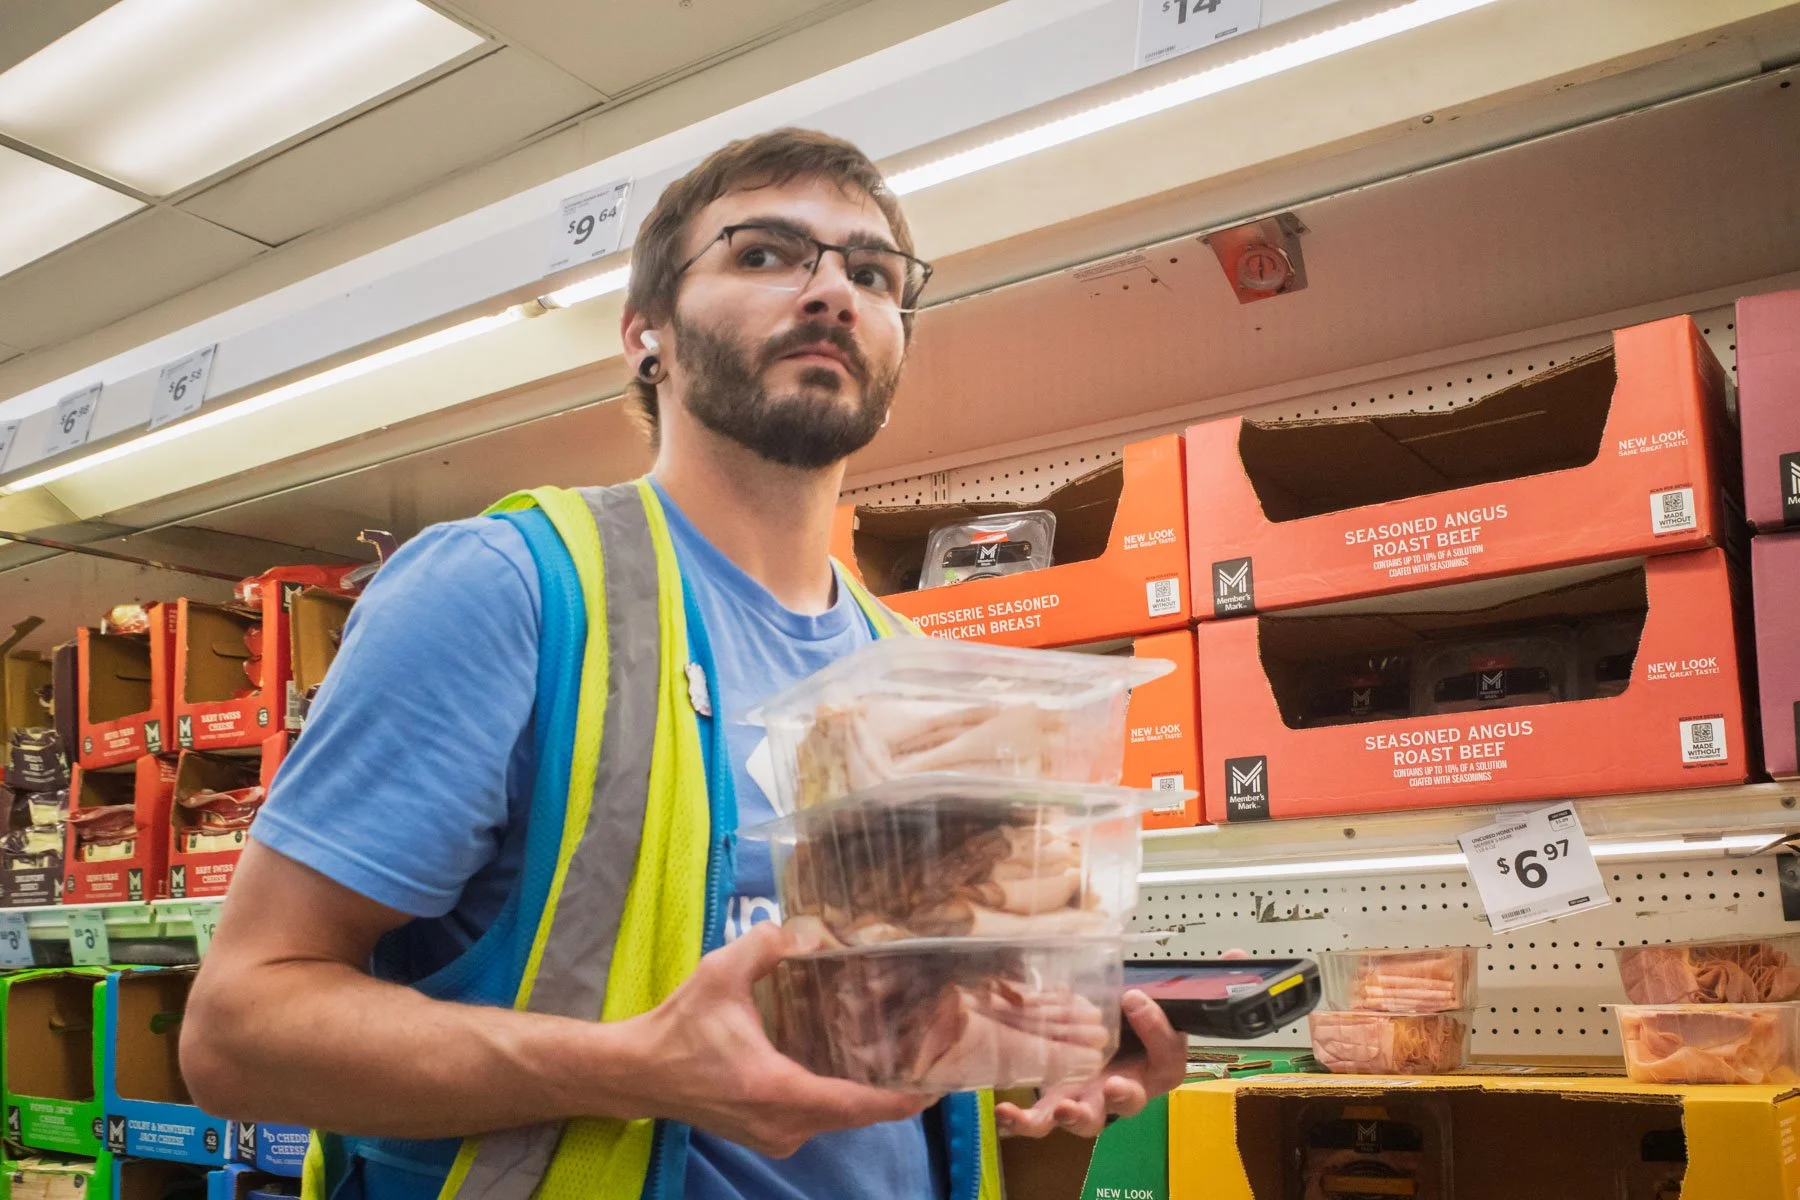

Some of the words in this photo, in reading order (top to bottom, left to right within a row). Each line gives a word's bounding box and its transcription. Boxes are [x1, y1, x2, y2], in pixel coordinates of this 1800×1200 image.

[1618, 437, 1647, 450] NEW
[1652, 429, 1686, 445] LOOK
[1659, 516, 1691, 526] WITHOUT
[1664, 511, 1684, 519] MADE
[1344, 517, 1438, 545] SEASONED
[1444, 504, 1508, 529] ANGUS
[1123, 533, 1146, 545] NEW
[1149, 528, 1175, 541] LOOK
[1373, 535, 1431, 558] ROAST
[1437, 526, 1482, 547] BEEF
[1403, 556, 1412, 565] UP
[1413, 555, 1421, 564] TO
[1438, 550, 1447, 560] OF
[1453, 544, 1483, 557] SOLUTION
[1389, 566, 1412, 578] COATED
[1413, 563, 1430, 574] WITH
[1430, 558, 1469, 573] SEASONINGS
[1216, 593, 1251, 606] Member's
[1224, 602, 1244, 612] Mark
[912, 606, 984, 628] ROTISSERIE
[988, 594, 1060, 617] SEASONED
[931, 623, 986, 641] CHICKEN
[990, 614, 1041, 634] BREAST
[1647, 661, 1677, 674] NEW
[1681, 657, 1718, 670] LOOK
[1647, 673, 1667, 681] SAME
[1669, 670, 1693, 679] GREAT
[1695, 667, 1720, 676] TASTE!
[1130, 727, 1153, 738] NEW
[1155, 724, 1180, 735] LOOK
[1365, 728, 1461, 751] SEASONED
[1467, 721, 1534, 741] ANGUS
[1393, 746, 1454, 766] ROAST
[1460, 741, 1506, 760] BEEF
[1688, 748, 1721, 757] WITHOUT
[1393, 767, 1423, 778] CONTAINS
[1424, 766, 1433, 776] UP
[1434, 765, 1443, 775] TO
[1444, 764, 1459, 774] 10%
[1460, 763, 1469, 773] OF
[1469, 763, 1475, 771] A
[1476, 760, 1508, 771] SOLUTION
[1409, 776, 1433, 787] COATED
[1433, 774, 1450, 785] WITH
[1452, 771, 1492, 784] SEASONINGS
[1229, 793, 1265, 804] Member's
[1237, 802, 1257, 811] Mark
[1472, 832, 1496, 844] UNCURED
[1496, 827, 1515, 838] HONEY
[1514, 823, 1528, 832] HAM
[1543, 838, 1569, 861] 97
[128, 1119, 151, 1131] COLBY
[157, 1123, 195, 1136] MONTEREY
[138, 1133, 157, 1144] JACK
[158, 1135, 185, 1146] CHEESE
[206, 1135, 217, 1145] 42
[277, 1133, 310, 1143] CHEDD
[271, 1144, 306, 1155] CHEESE
[1096, 1188, 1121, 1198] NEW
[1125, 1189, 1153, 1200] LOOK
